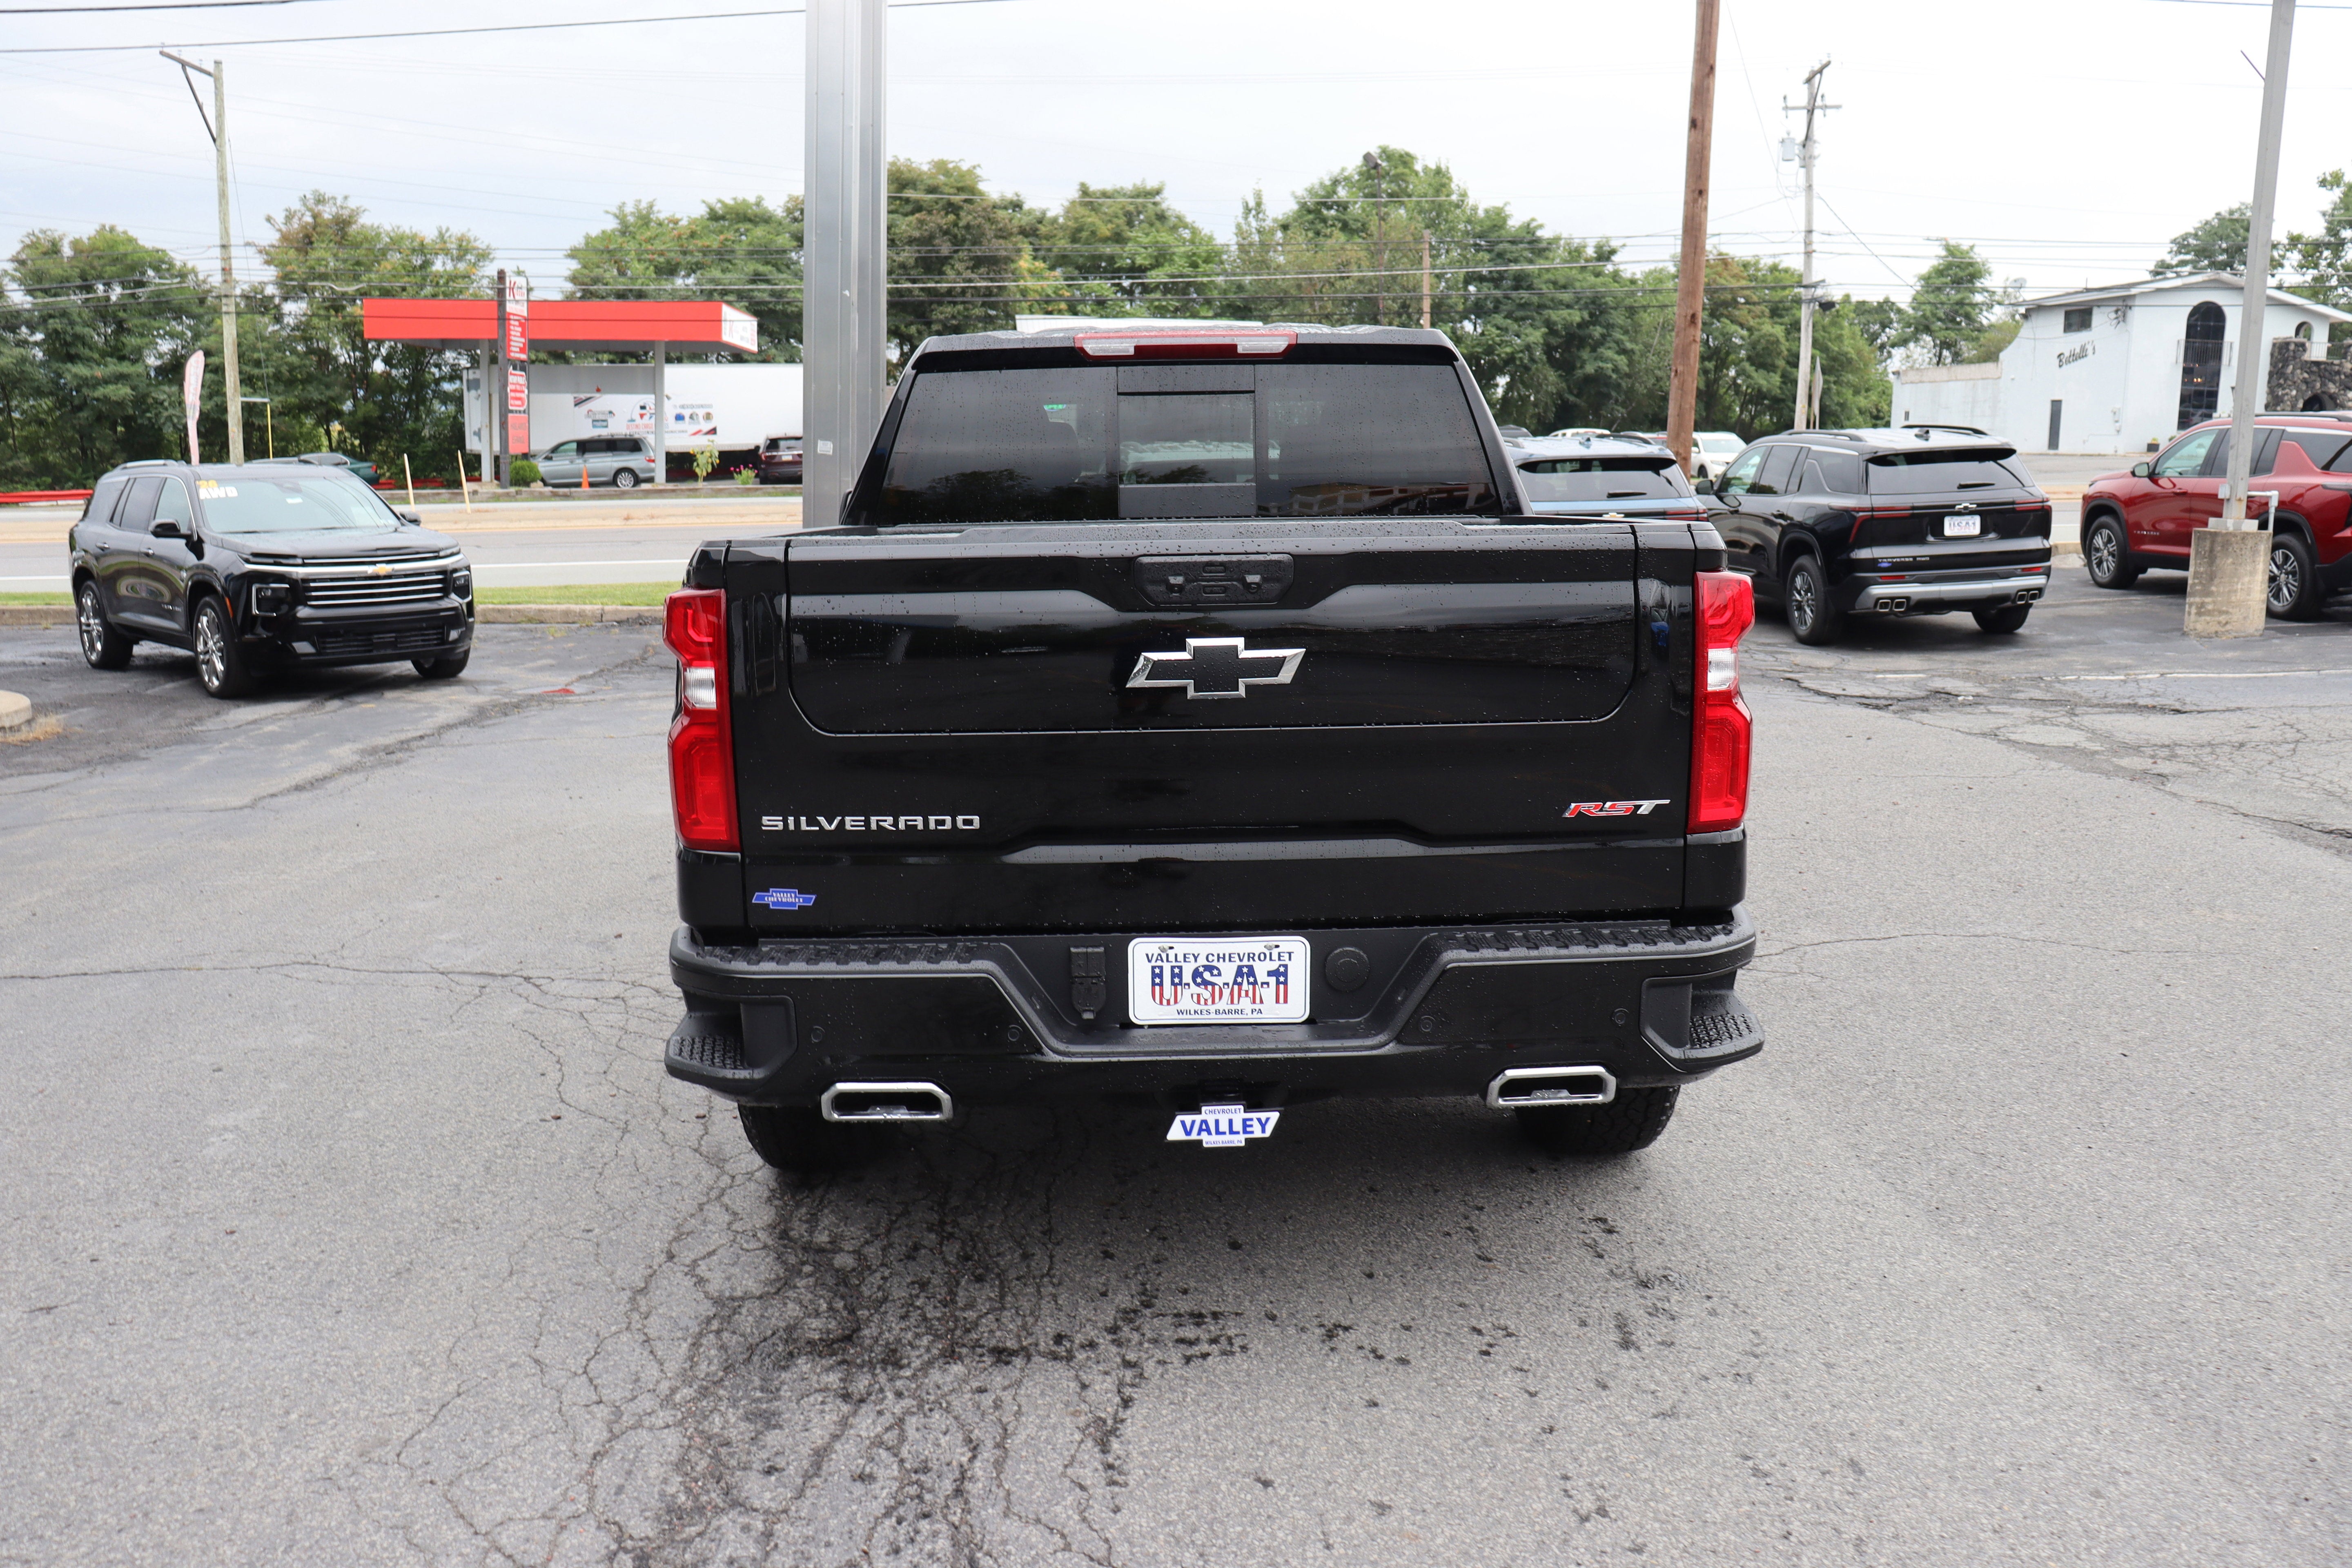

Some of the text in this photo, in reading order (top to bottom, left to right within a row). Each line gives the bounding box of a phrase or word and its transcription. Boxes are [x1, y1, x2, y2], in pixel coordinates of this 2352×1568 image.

[199, 486, 238, 500] AWD
[1561, 799, 1671, 818] RST
[761, 815, 980, 831] SILVERADO
[1145, 951, 1294, 963] VALLEY CHEVROLET
[1179, 1117, 1271, 1137] VALLEY
